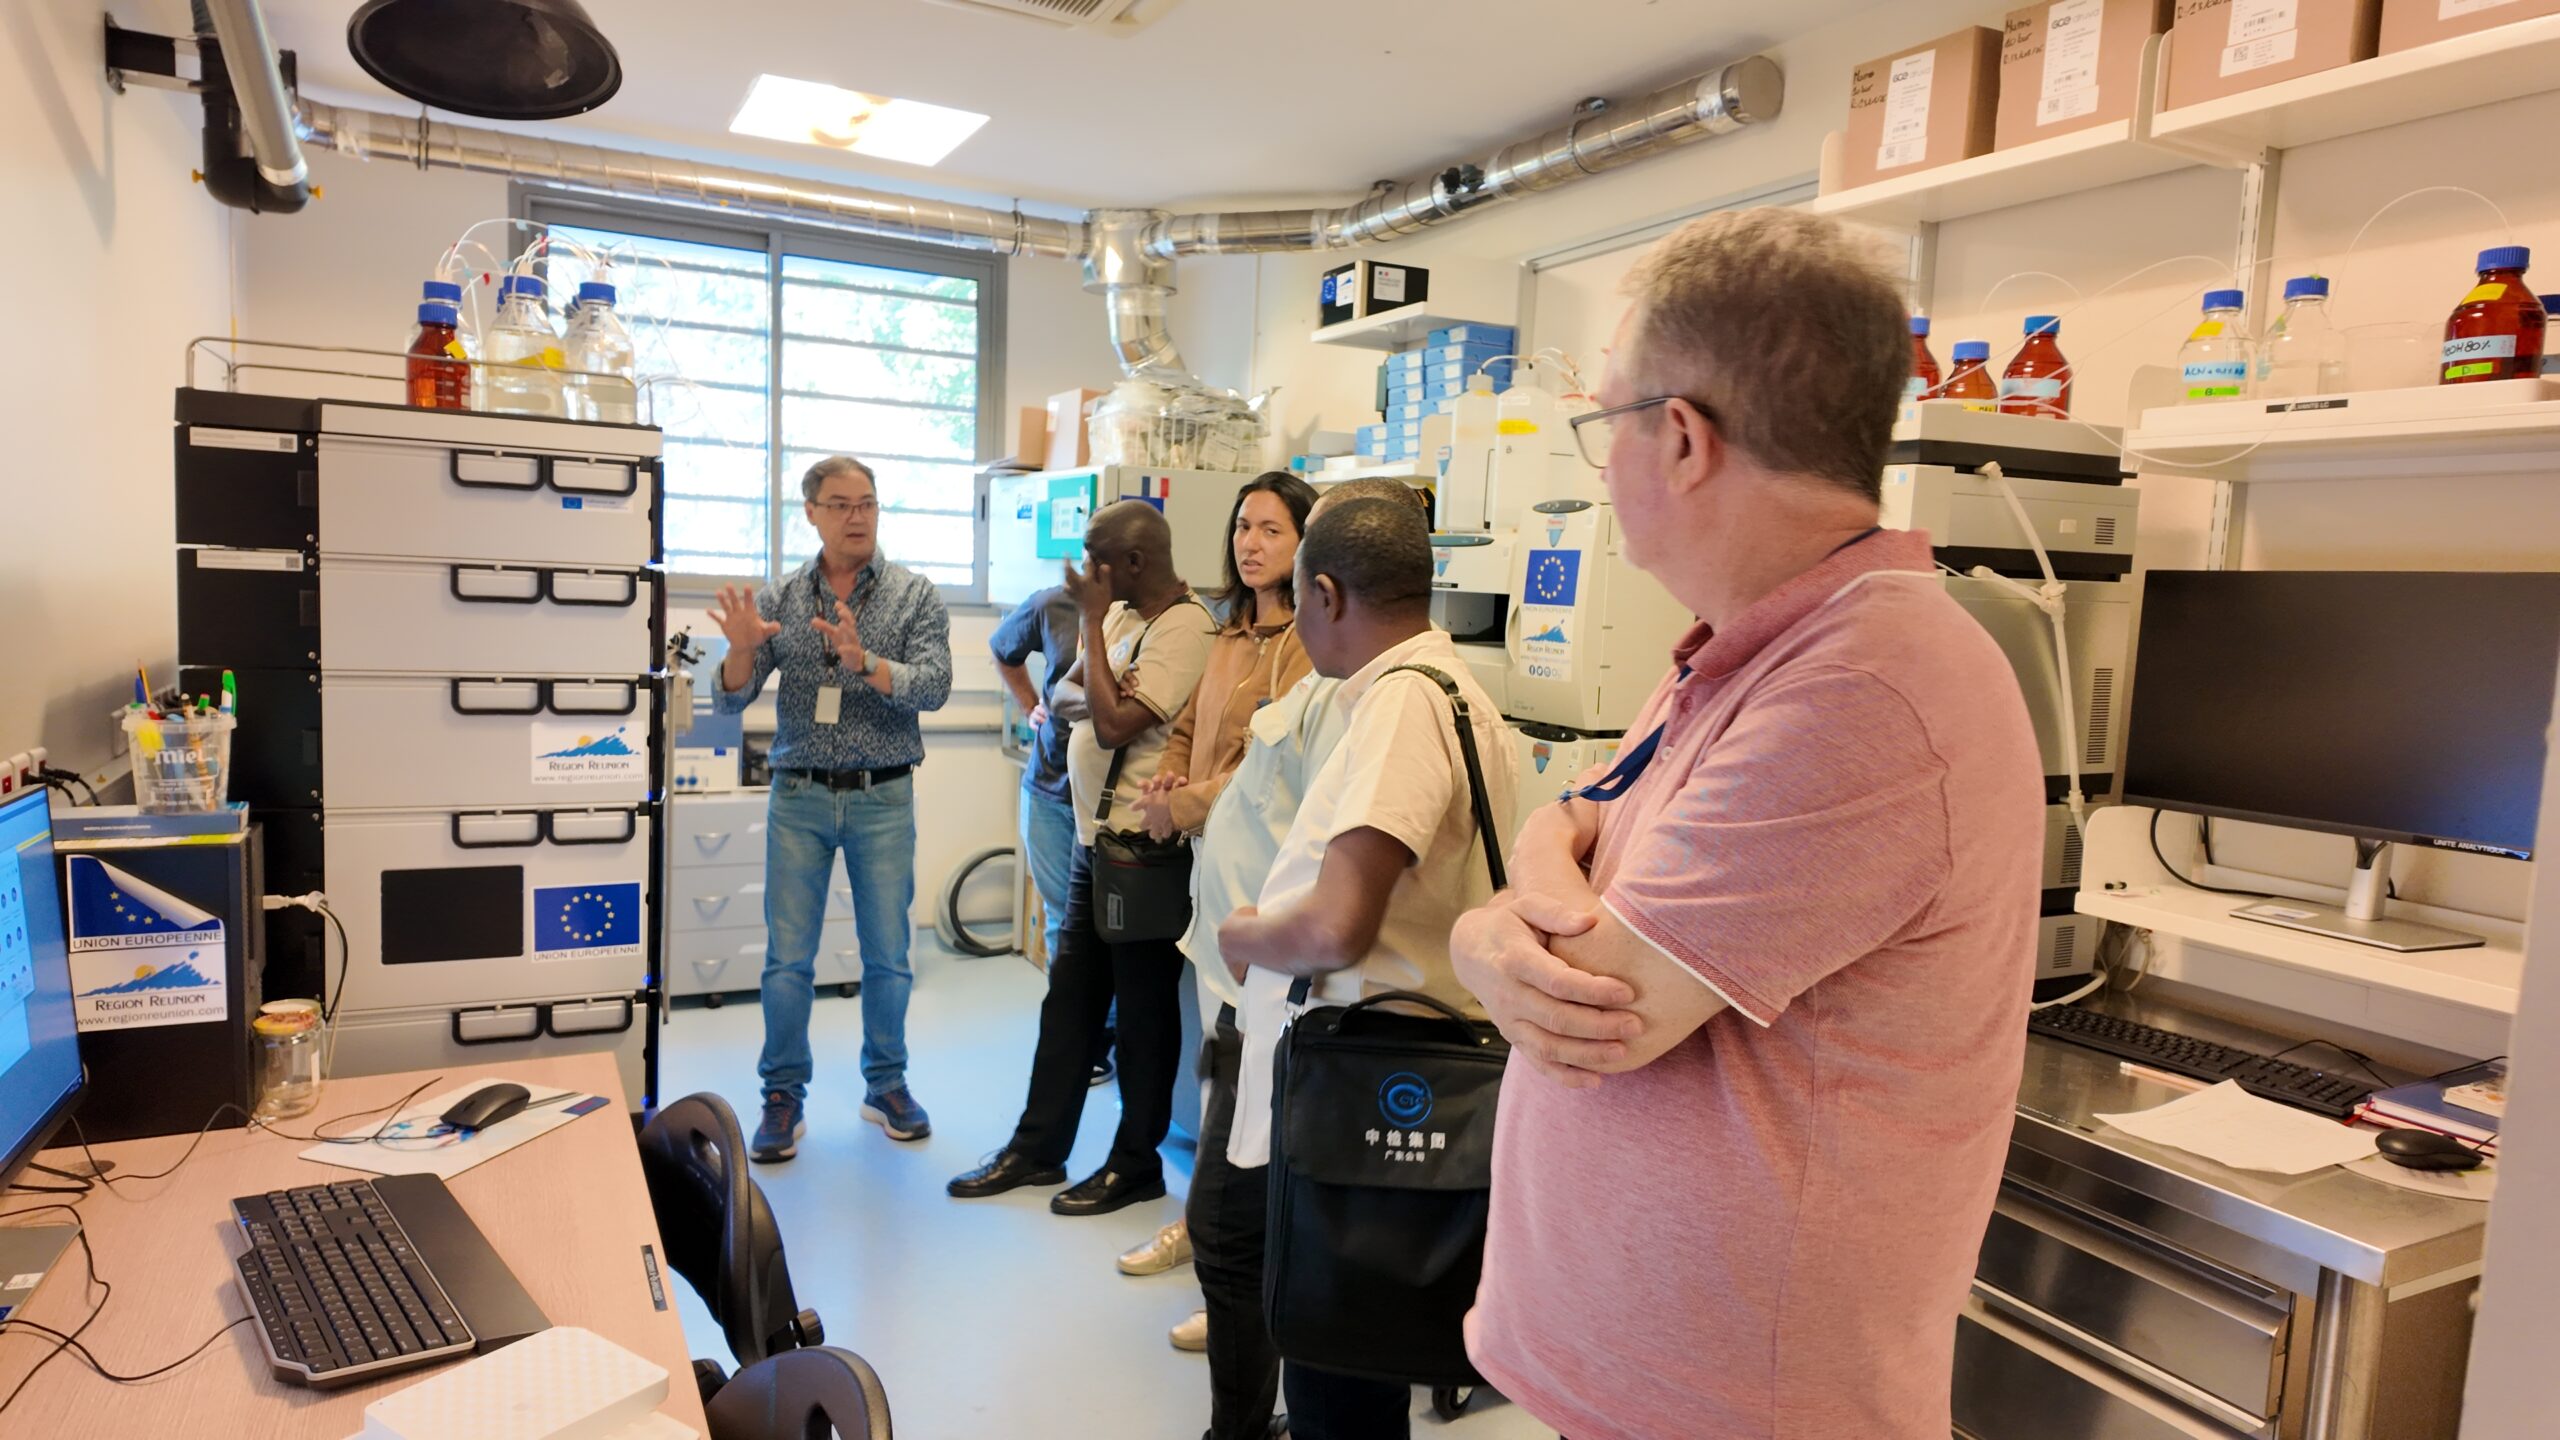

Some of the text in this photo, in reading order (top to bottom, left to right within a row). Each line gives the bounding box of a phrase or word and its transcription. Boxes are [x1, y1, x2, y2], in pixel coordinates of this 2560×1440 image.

[549, 760, 630, 771] REGION REUNION
[73, 930, 222, 950] UNION EUROPEENNE
[534, 950, 568, 961] UNION
[95, 993, 206, 1012] REGION REUNION
[77, 1005, 225, 1026] www.regionreunion.com
